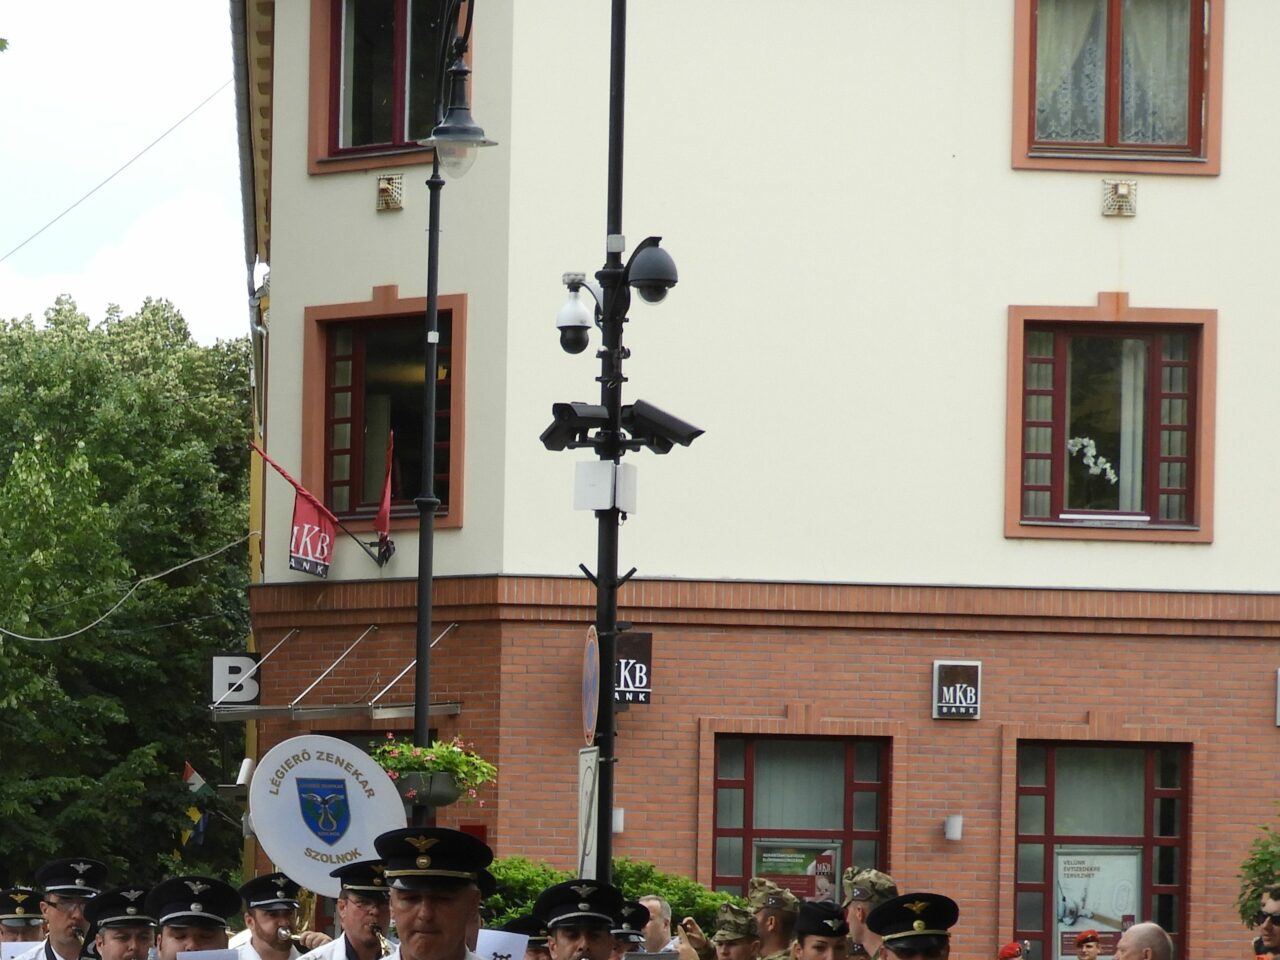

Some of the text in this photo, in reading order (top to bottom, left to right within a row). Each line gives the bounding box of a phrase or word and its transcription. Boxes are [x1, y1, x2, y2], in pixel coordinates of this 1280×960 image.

[290, 558, 324, 575] ANK
[212, 655, 260, 703] B
[615, 658, 648, 690] KB
[614, 691, 646, 702] ANK
[942, 683, 976, 706] MKB
[942, 706, 975, 714] BANK
[269, 748, 376, 799] LÉGIERŐ ZENEKAR
[303, 847, 363, 866] SZOLNOK
